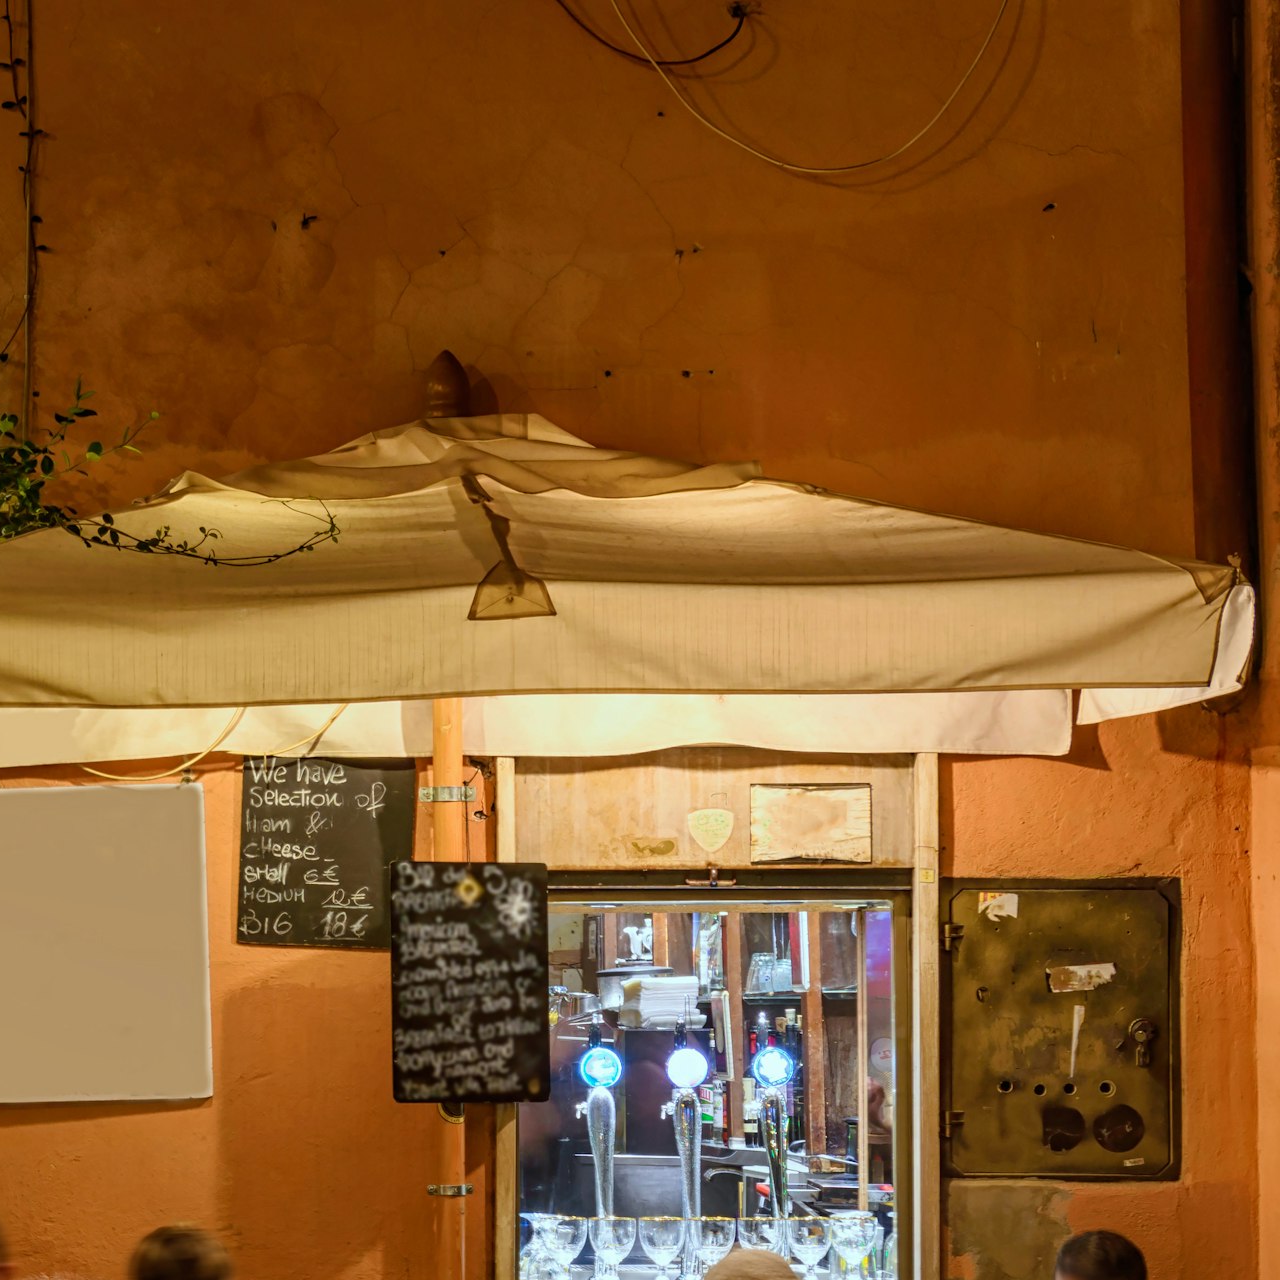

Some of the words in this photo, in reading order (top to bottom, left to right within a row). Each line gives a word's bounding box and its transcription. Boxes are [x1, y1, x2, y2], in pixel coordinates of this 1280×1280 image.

[250, 756, 287, 784] We
[296, 758, 347, 785] have
[250, 786, 342, 807] Selection
[355, 782, 386, 818] of
